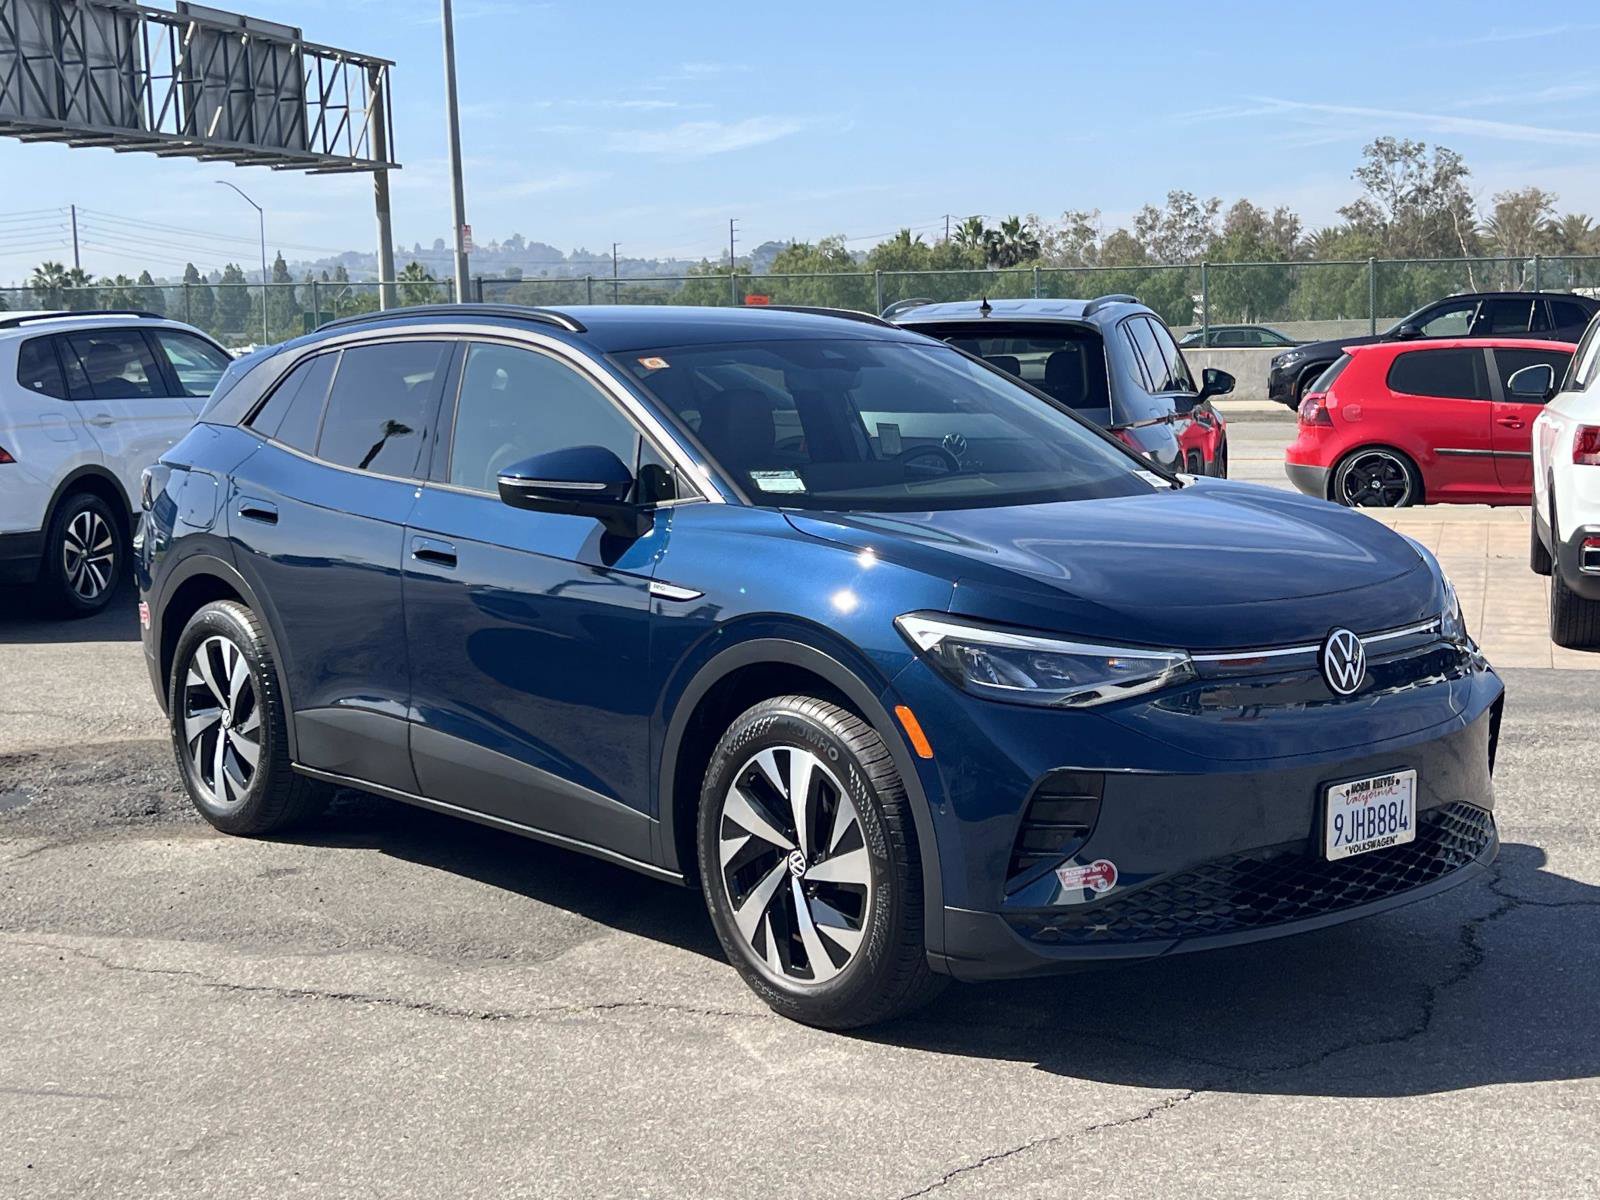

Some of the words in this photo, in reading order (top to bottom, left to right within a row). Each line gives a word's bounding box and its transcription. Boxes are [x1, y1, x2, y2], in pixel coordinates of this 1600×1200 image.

[786, 720, 839, 761] KUMHO
[1351, 781, 1370, 794] NORM
[1334, 799, 1408, 847] 9JHB884
